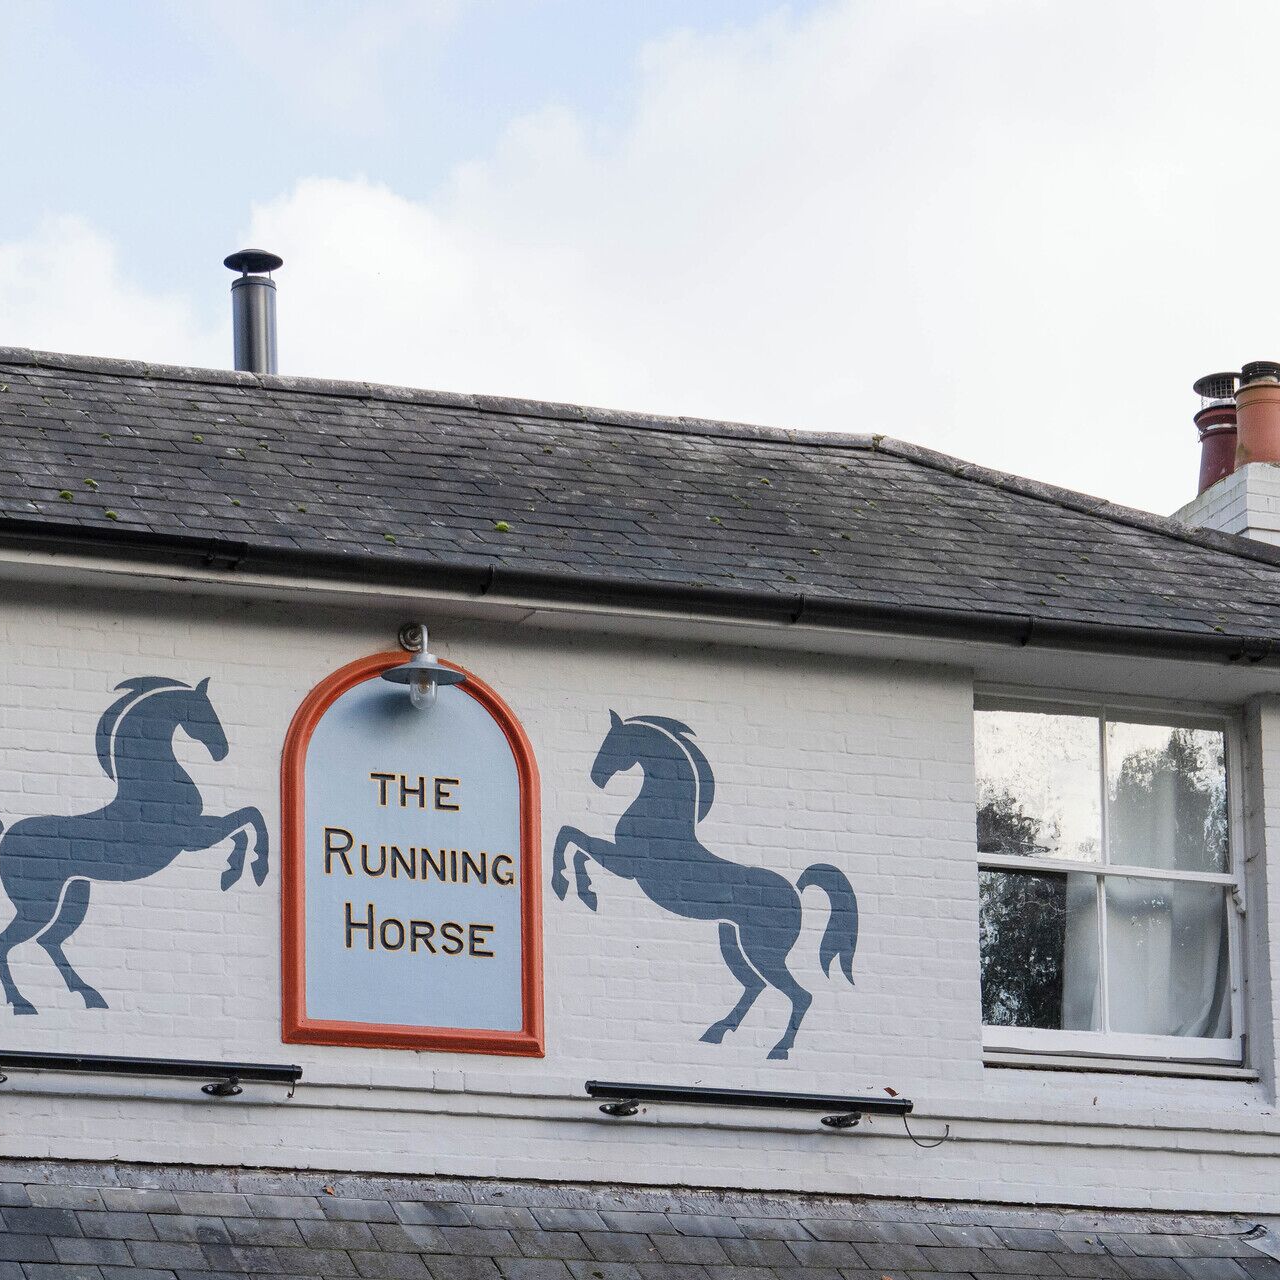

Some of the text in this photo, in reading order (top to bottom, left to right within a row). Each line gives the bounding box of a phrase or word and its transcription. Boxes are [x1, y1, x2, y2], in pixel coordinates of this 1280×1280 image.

[369, 772, 461, 811] THE
[322, 826, 516, 886] RUNNING
[343, 902, 497, 958] HORSE
